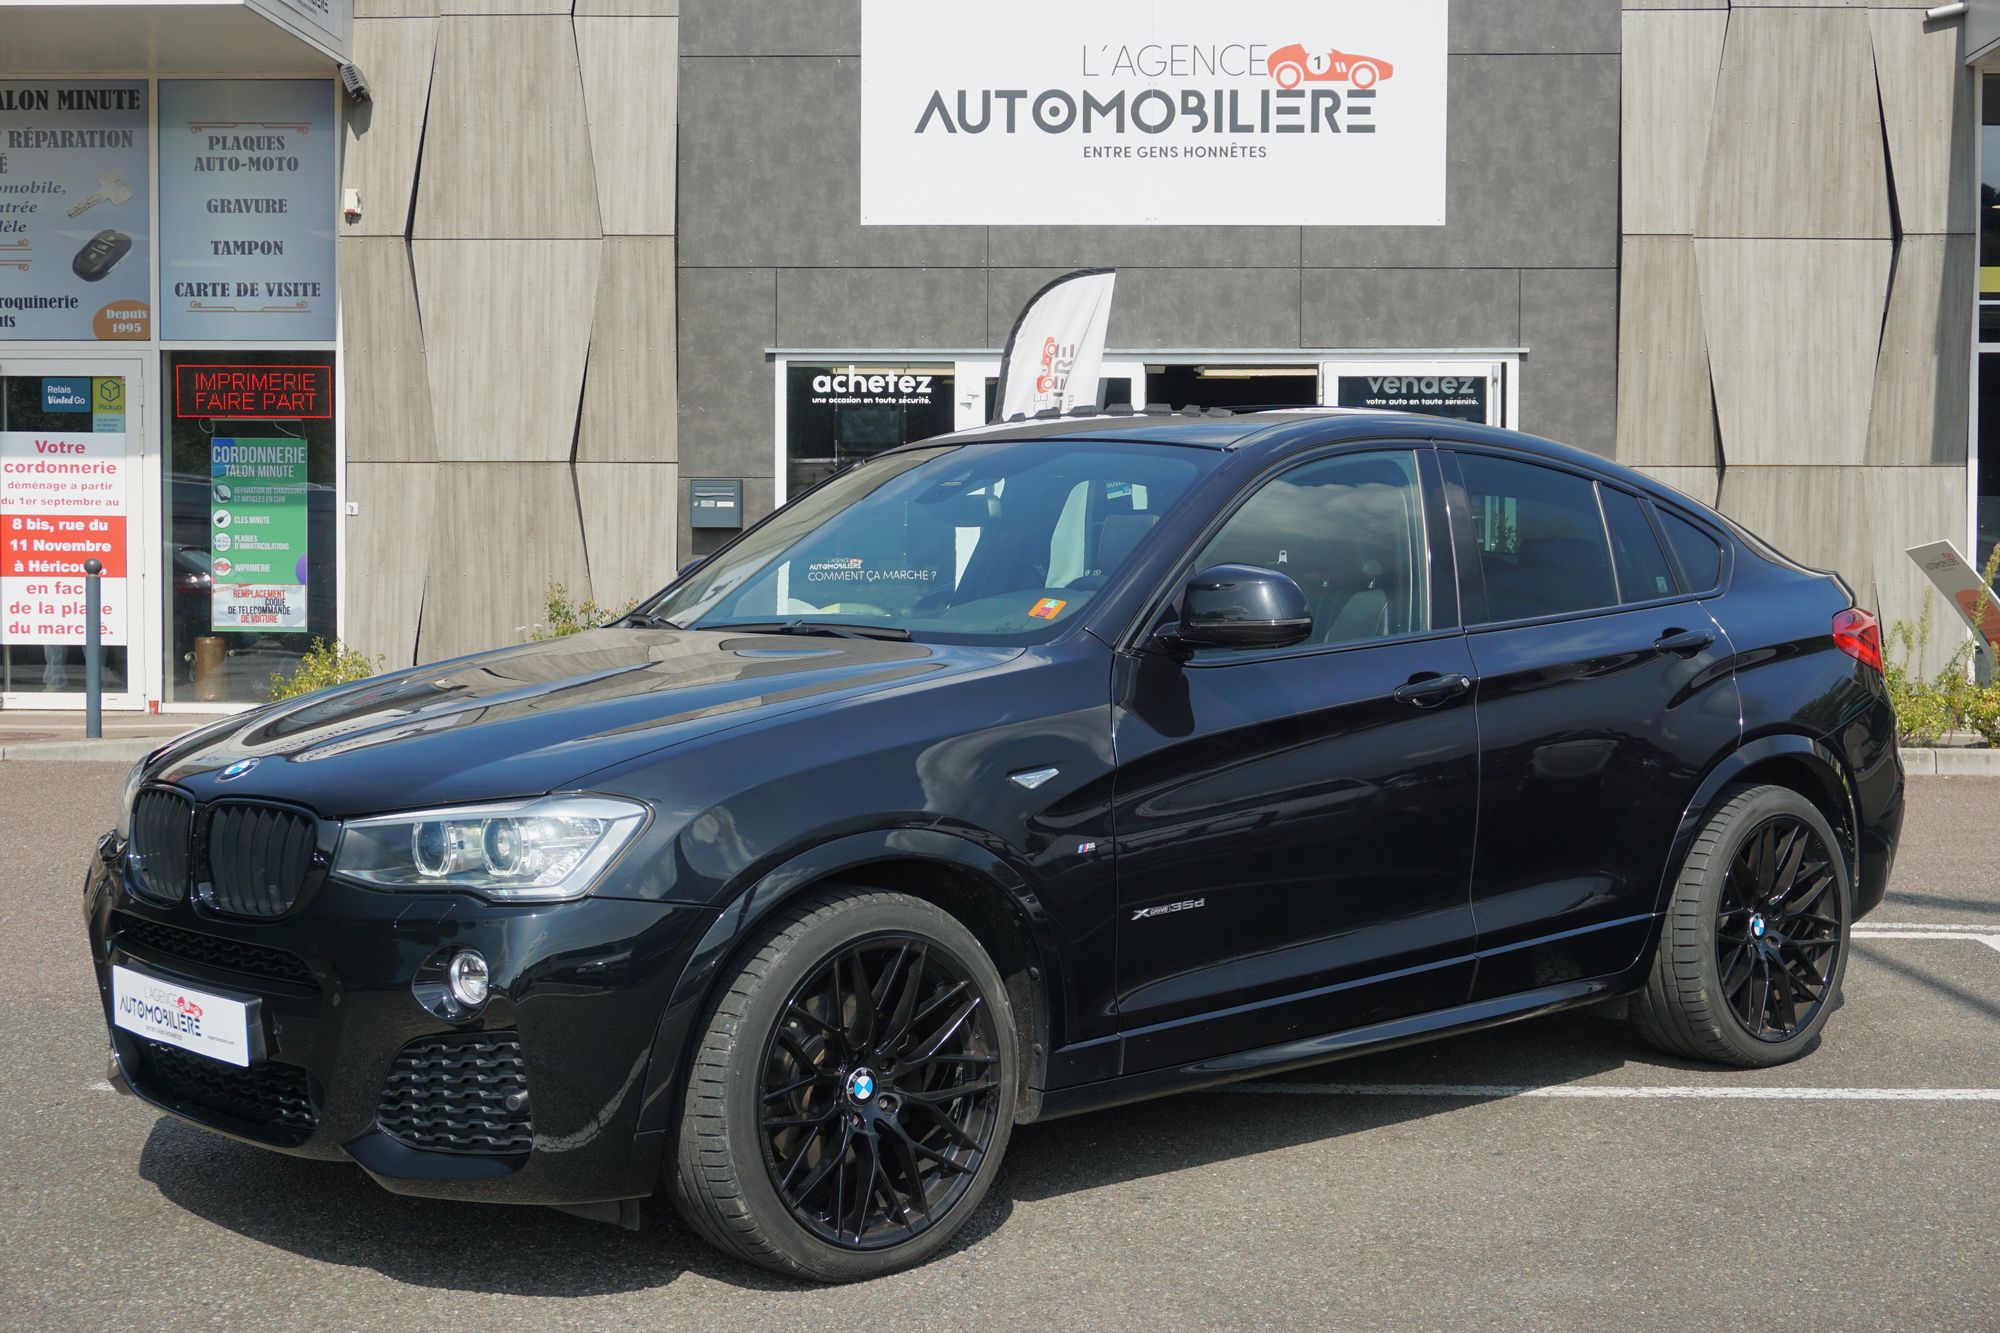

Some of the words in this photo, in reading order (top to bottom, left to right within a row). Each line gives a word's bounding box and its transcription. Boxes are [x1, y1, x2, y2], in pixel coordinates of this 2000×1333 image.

[57, 89, 141, 110] MINUTE
[8, 126, 133, 148] RÉPARATION
[207, 135, 286, 152] PLAQUES
[1083, 145, 1132, 158] ENTRE
[1136, 145, 1179, 158] GENS
[1183, 141, 1268, 158] HONNÊTES
[193, 156, 299, 172] AUTO-MOTO
[0, 181, 66, 195] mobile,
[206, 198, 288, 214] GRAVURE
[210, 240, 284, 255] TAMPON
[174, 282, 230, 297] CARTE
[236, 282, 259, 297] DE
[264, 282, 321, 297] VISITE
[105, 309, 148, 321] Depuis
[112, 323, 142, 333] 1995
[194, 372, 316, 391] IMPRIMERIE
[812, 364, 933, 394] achetez
[47, 385, 71, 394] Relais
[47, 395, 73, 405] Vinted
[74, 396, 86, 404] Go
[196, 392, 255, 410] FAIRE
[263, 392, 317, 410] PART
[828, 395, 862, 404] occasion
[875, 396, 897, 404] toute
[898, 395, 932, 404] sécurité.
[1366, 397, 1387, 405] votre
[1388, 397, 1408, 405] auto
[1421, 397, 1443, 405] toute
[1445, 396, 1479, 405] sérénité.
[98, 403, 122, 411] Pickup
[34, 439, 86, 454] Votre
[212, 445, 306, 464] CORDONNERIE
[3, 460, 117, 474] cordonnerie
[225, 464, 255, 478] TALON
[257, 465, 294, 478] MINUTE
[80, 482, 113, 491] partir
[1, 496, 15, 506] du
[19, 496, 38, 506] 1er
[40, 497, 102, 508] septembre
[12, 518, 22, 531] 8
[26, 518, 55, 533] bis,
[58, 520, 85, 531] rue
[88, 519, 109, 531] du
[248, 516, 271, 525] MINUTE
[9, 538, 28, 551] 11
[33, 539, 112, 553] Novembre
[14, 559, 25, 573] à
[807, 570, 865, 582] COMMENT
[866, 570, 881, 583] ÇA
[882, 569, 929, 581] MARCHE
[931, 570, 938, 580] ?
[26, 583, 49, 595] en
[54, 581, 84, 595] fac
[232, 589, 287, 599] REMPLACEMENT
[9, 601, 32, 615] de
[38, 601, 55, 615] la
[61, 601, 113, 618] plae
[227, 605, 237, 615] DE
[240, 614, 249, 624] DE
[251, 614, 279, 624] VOITURE
[8, 621, 31, 635] du
[37, 620, 114, 635] marcé.
